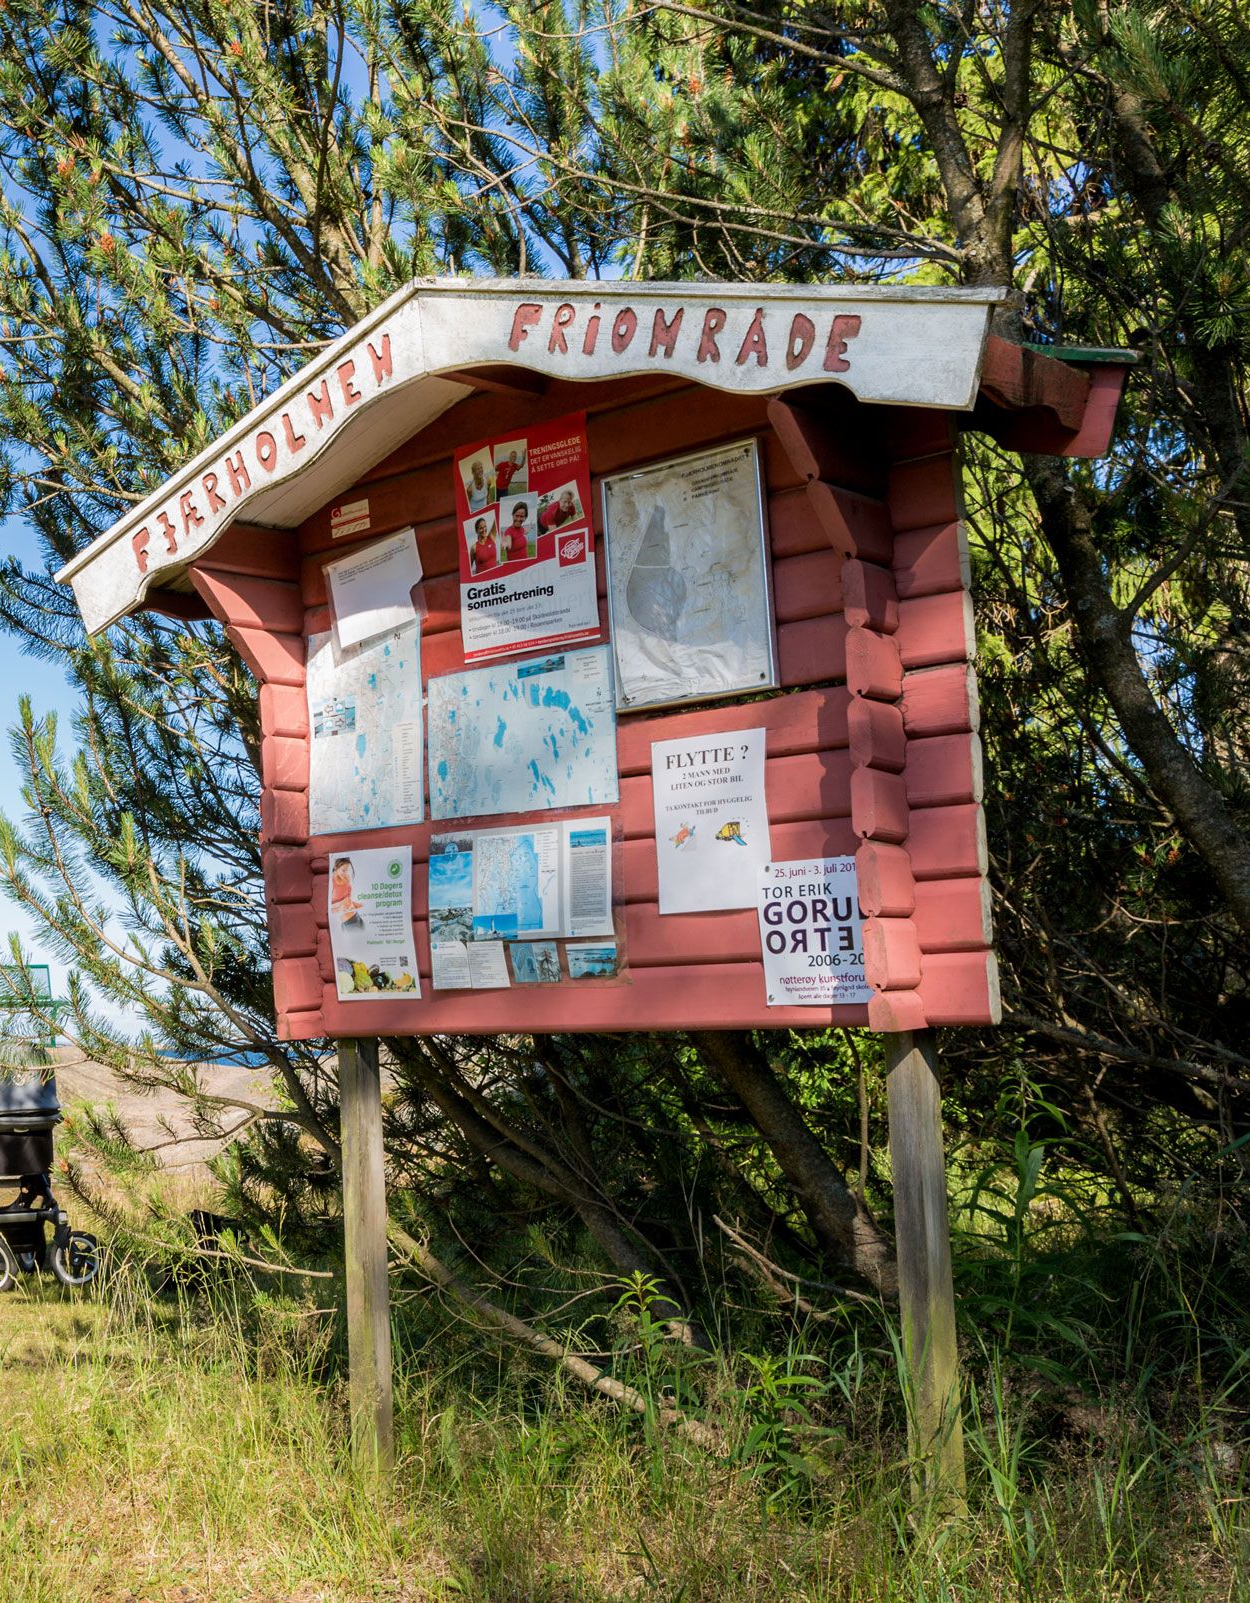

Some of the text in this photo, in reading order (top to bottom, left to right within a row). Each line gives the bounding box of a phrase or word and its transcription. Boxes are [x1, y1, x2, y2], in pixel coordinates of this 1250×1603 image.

[529, 436, 581, 456] TRENINGSGLEDE
[530, 445, 582, 465] DET ER VANSKELIG
[536, 461, 555, 473] SETTE
[555, 457, 568, 467] ORD
[466, 582, 506, 600] Gratis
[467, 584, 555, 611] sommertrening
[665, 744, 749, 770] FLYTTE ?
[688, 769, 711, 779] MANN
[712, 767, 731, 776] MED
[670, 781, 694, 791] LITEN
[694, 779, 707, 787] OG
[708, 776, 729, 787] STOR
[673, 802, 703, 811] KONTAKT
[717, 795, 753, 806] HYGGELIG
[695, 807, 719, 816] TILBUD
[774, 868, 788, 878] 25.
[788, 866, 806, 879] juni
[814, 866, 822, 875] 3.
[823, 863, 837, 876] juli
[840, 862, 857, 873] 201
[371, 881, 403, 892] 10 Dagers
[762, 882, 832, 900] TOR ERIK
[357, 890, 403, 901] cleanse/detox
[375, 899, 403, 909] program
[808, 953, 865, 967] 2006-20
[779, 972, 866, 986] nøtterøy kunstforu
